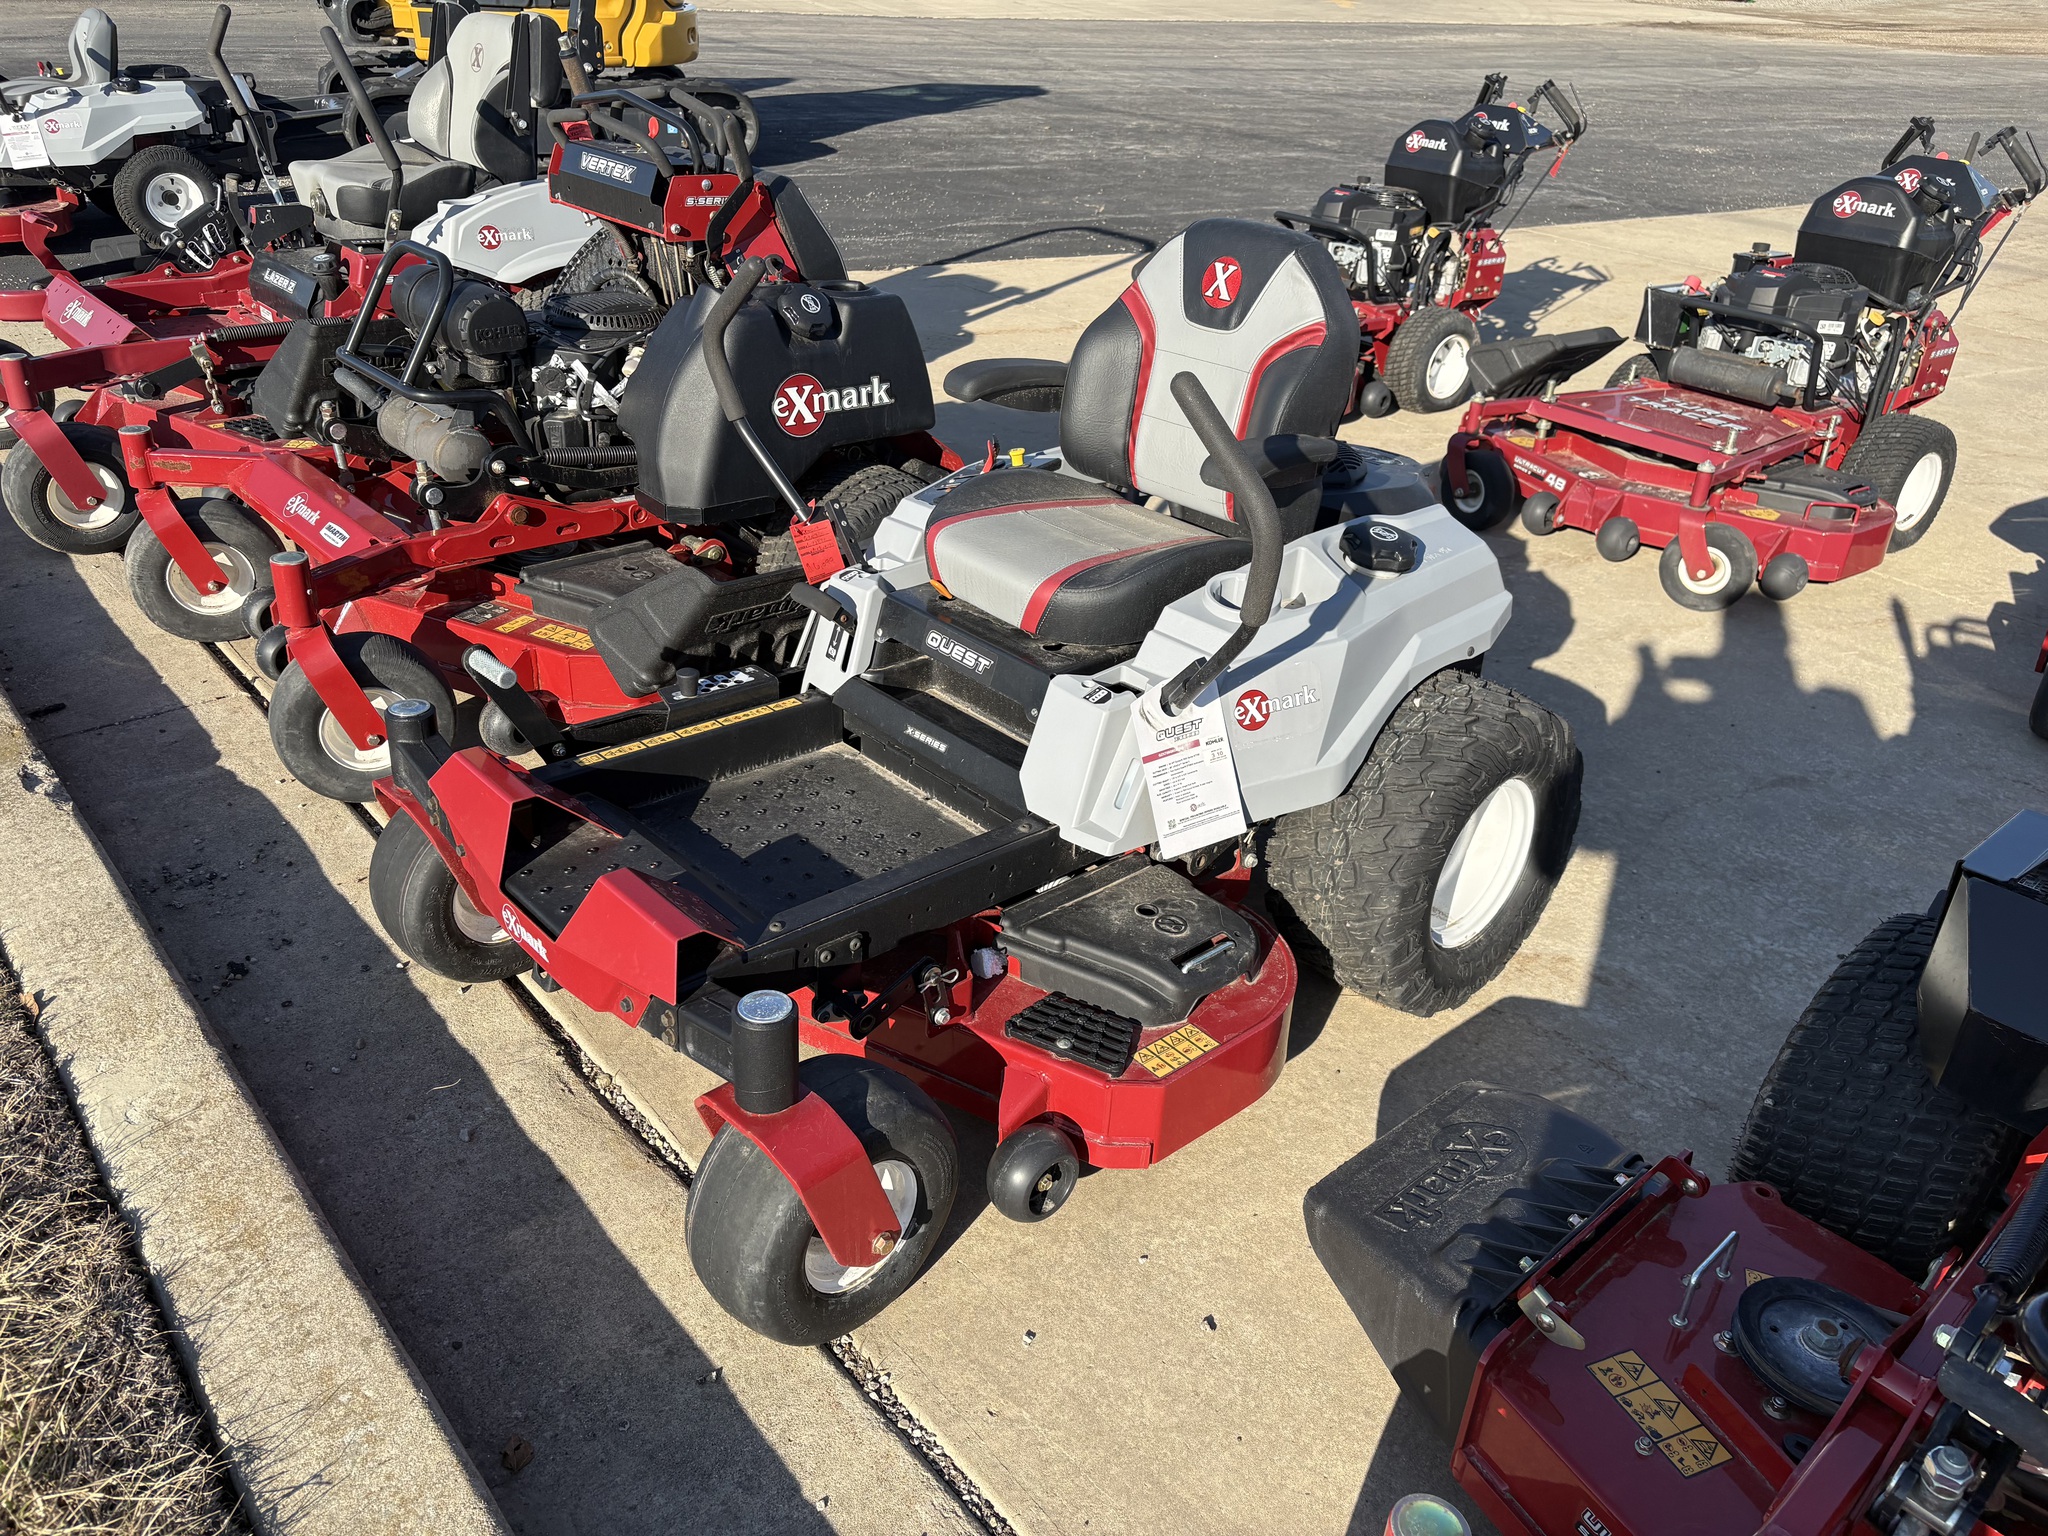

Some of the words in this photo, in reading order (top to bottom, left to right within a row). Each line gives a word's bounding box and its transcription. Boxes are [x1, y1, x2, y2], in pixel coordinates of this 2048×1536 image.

[44, 119, 81, 133] eXmark
[1406, 131, 1449, 151] eXmark
[582, 152, 636, 183] VERTEX
[1832, 194, 1897, 218] eXmark
[476, 226, 533, 247] eXmark
[263, 268, 290, 290] LAZER
[1204, 261, 1238, 301] X
[62, 298, 94, 327] eXmark
[772, 375, 894, 430] eXmark
[1626, 396, 1751, 431] TRACER
[1545, 473, 1567, 492] 48
[285, 494, 321, 526] eXmark
[325, 524, 348, 542] MARTIN
[926, 630, 994, 674] QUEST
[1234, 685, 1320, 727] eXmark
[1156, 718, 1204, 741] QUEST
[1205, 737, 1224, 746] KOHLER
[502, 906, 549, 963] eXmark
[1383, 1128, 1513, 1224] eXmark
